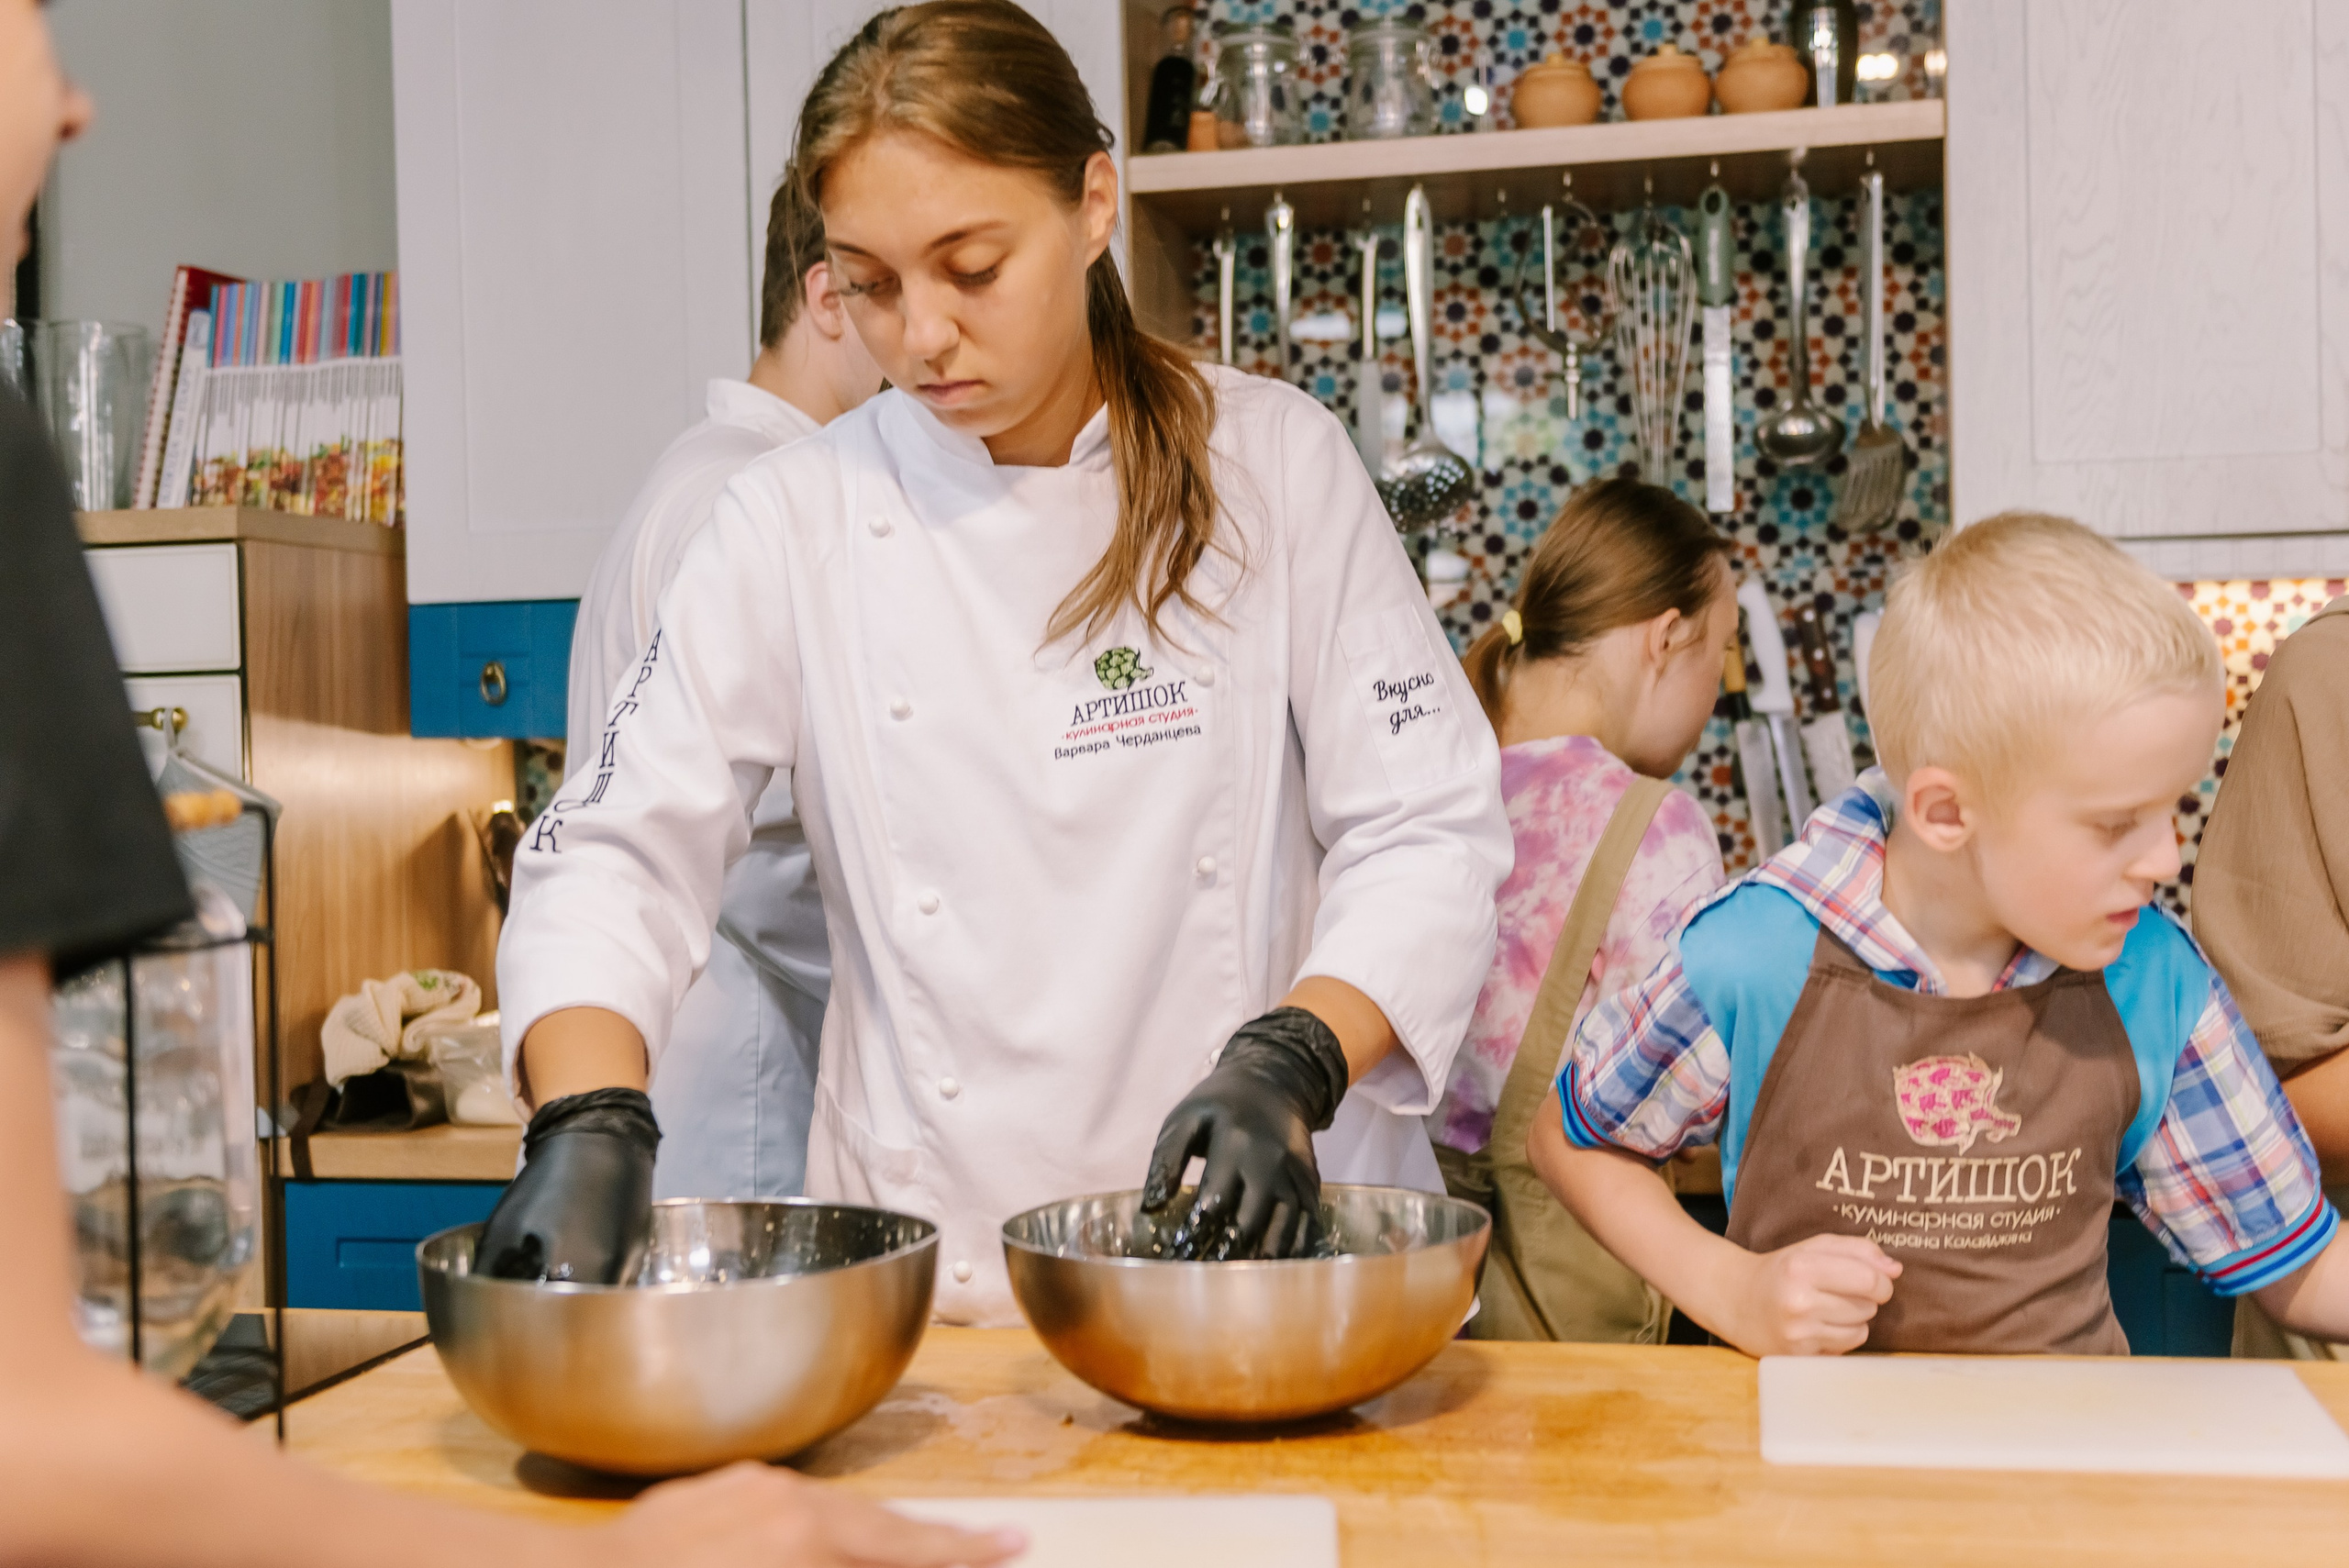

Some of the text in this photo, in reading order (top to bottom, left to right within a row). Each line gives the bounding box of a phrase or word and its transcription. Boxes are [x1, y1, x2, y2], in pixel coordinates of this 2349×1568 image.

[1071, 681, 1188, 727] АРТИШОК
[1373, 673, 1434, 703] Вкусно
[529, 628, 662, 853] АРТИШОК
[1054, 724, 1201, 760] Варвара Черданцева
[1816, 1147, 2081, 1204] АРТИШОК
